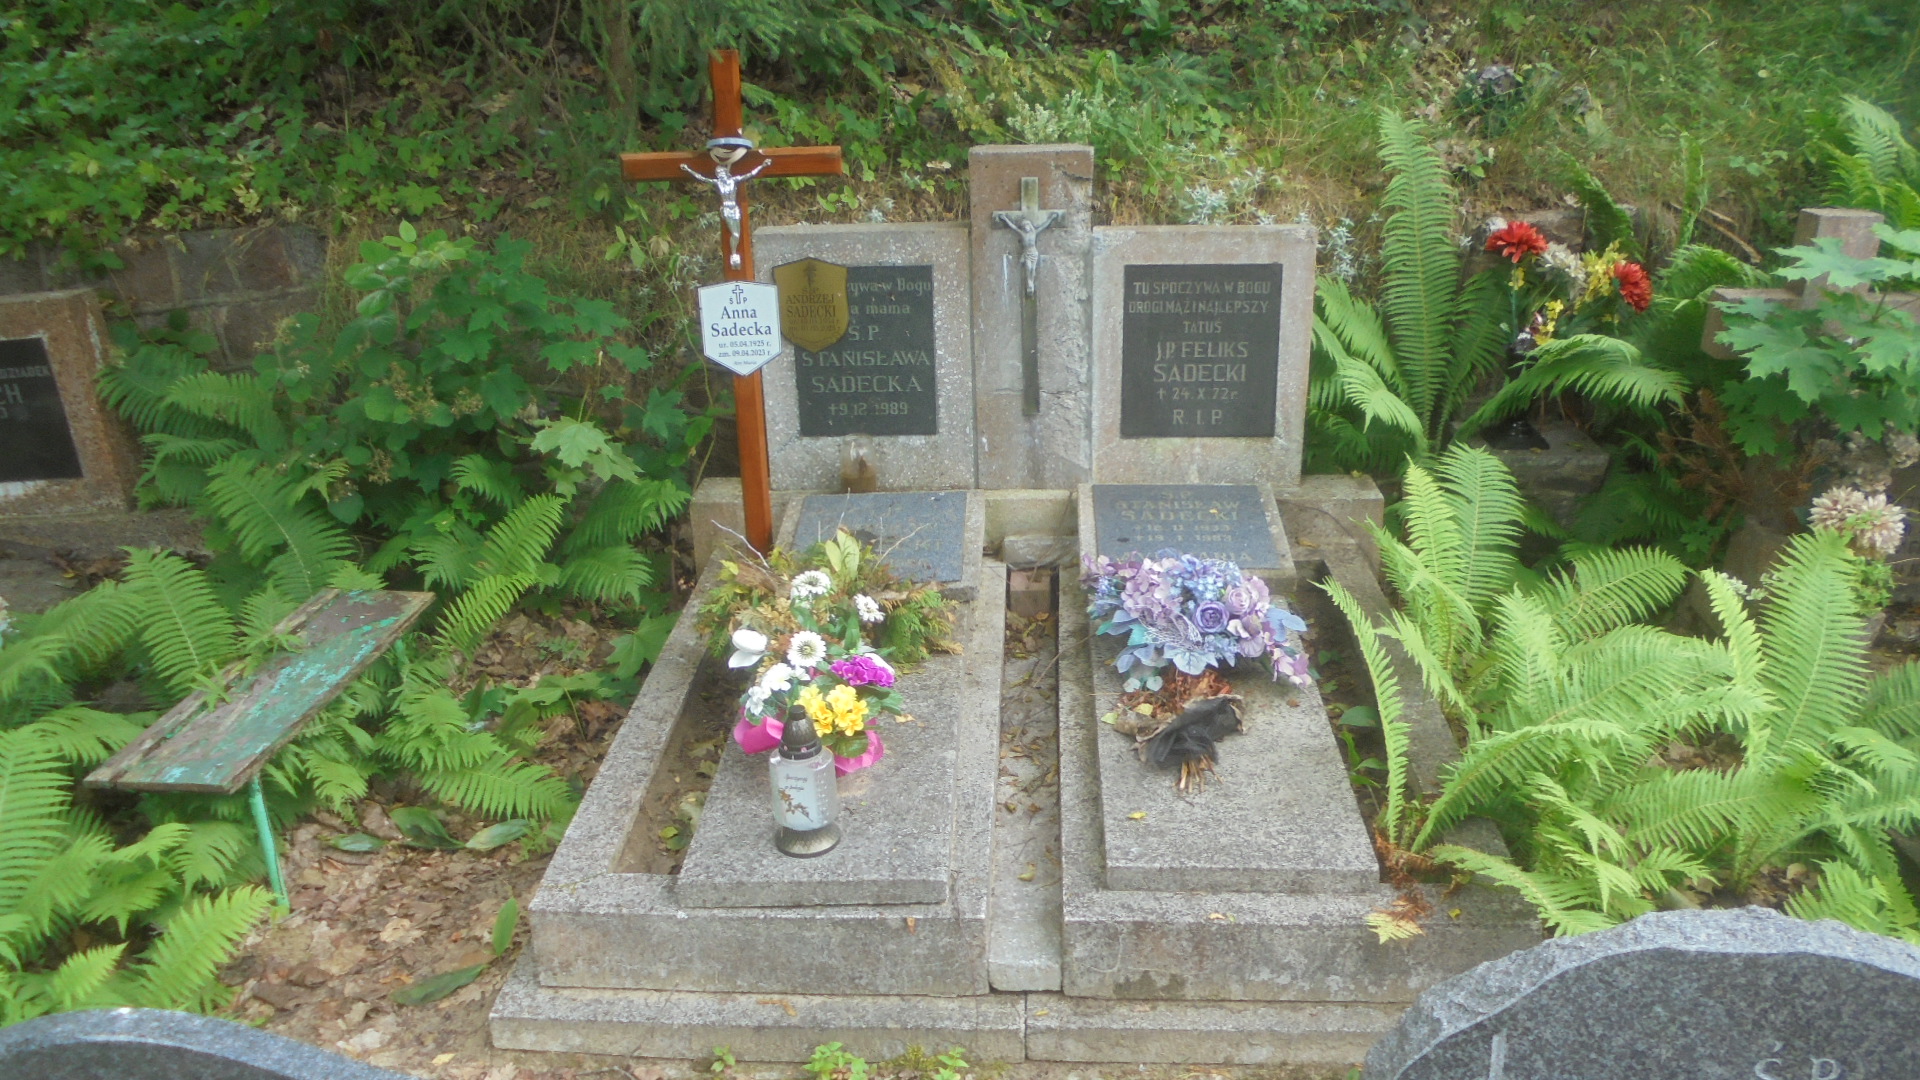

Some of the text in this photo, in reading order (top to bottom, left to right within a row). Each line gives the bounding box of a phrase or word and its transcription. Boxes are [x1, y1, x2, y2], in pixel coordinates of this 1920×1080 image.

[897, 278, 931, 296] Bogu
[1133, 281, 1271, 295] TU SPOCZYWA W BOGU
[786, 294, 835, 305] ANDRZEJ
[721, 306, 758, 319] Anna
[787, 305, 837, 318] SADECKI
[866, 304, 911, 315] mama
[711, 322, 772, 337] Sadecka
[1181, 341, 1249, 358] FELIKS
[802, 351, 930, 367] STANISŁAWA
[1153, 364, 1247, 383] SADECKI
[812, 376, 923, 393] SADECKA
[1121, 510, 1238, 521] SADECKI
